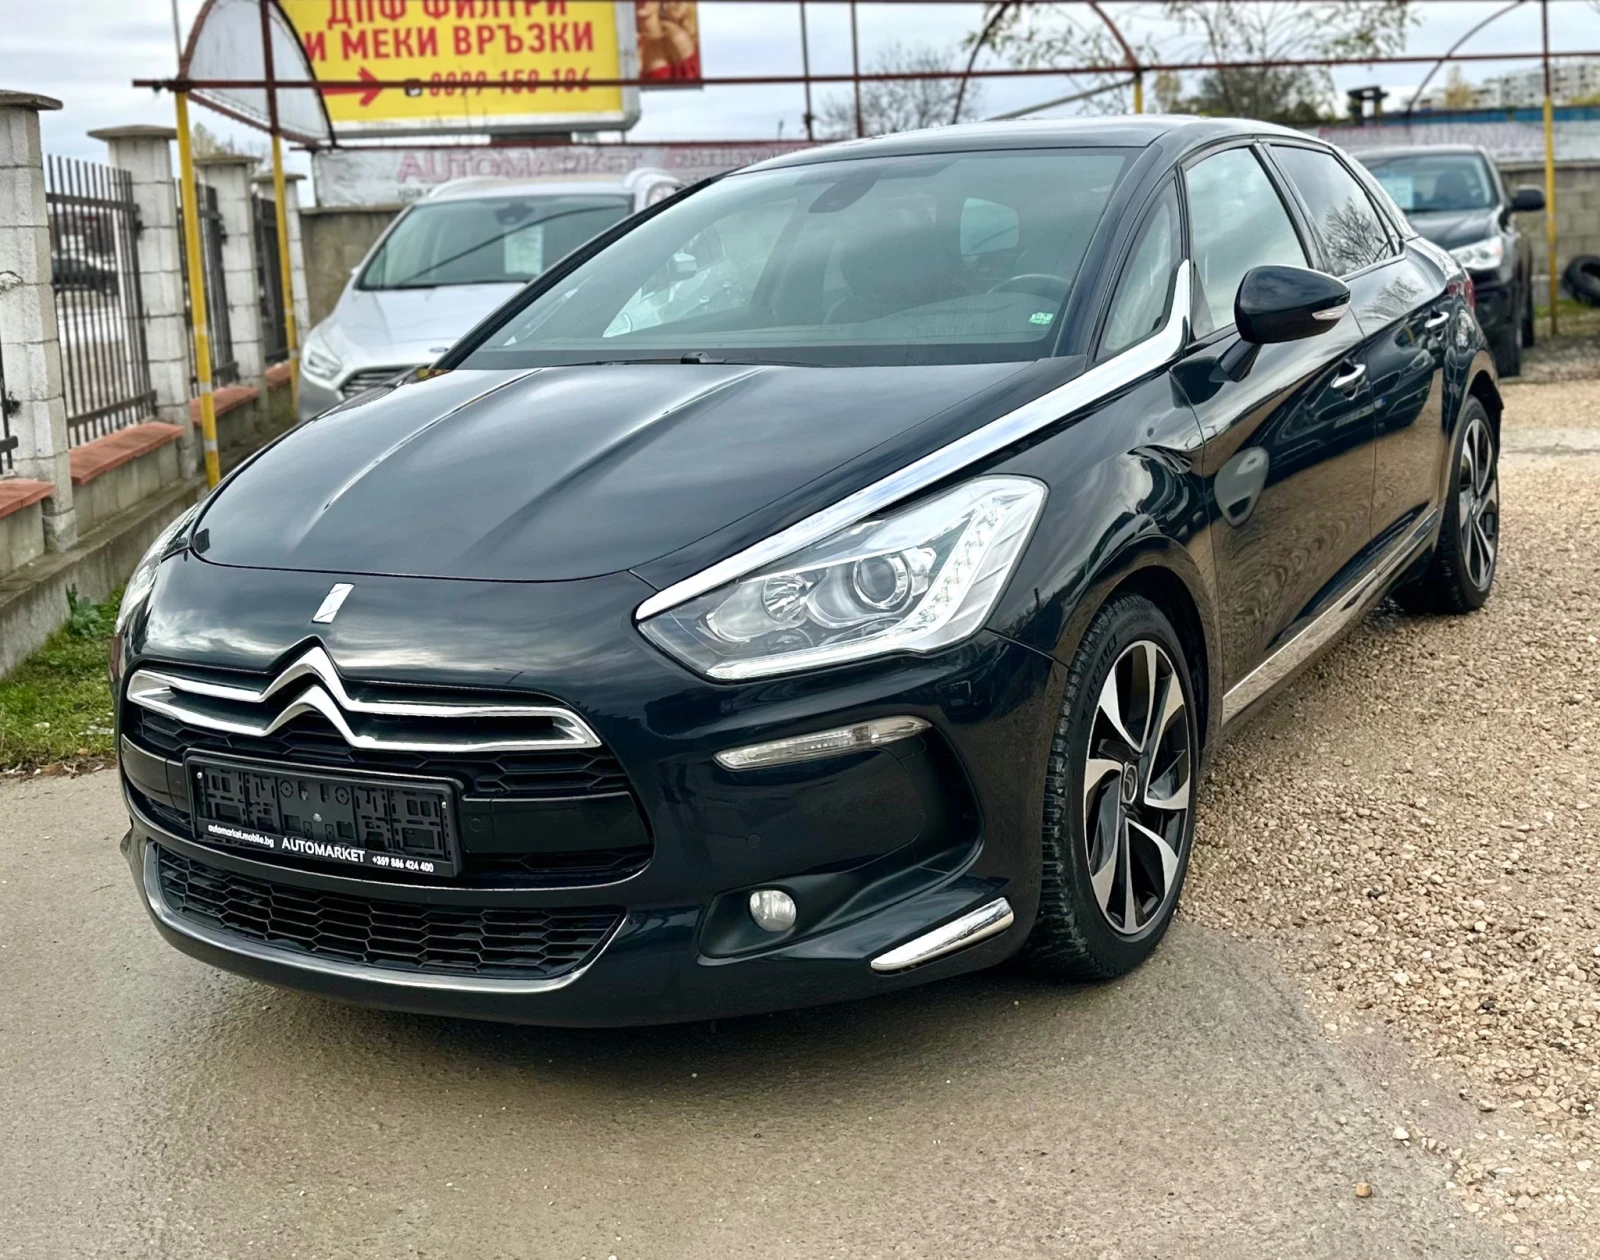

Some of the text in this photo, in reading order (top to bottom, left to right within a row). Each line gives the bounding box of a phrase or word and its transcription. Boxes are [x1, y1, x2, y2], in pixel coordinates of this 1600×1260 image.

[304, 21, 594, 62] И МЕКИ ВРЪЗКИ
[397, 149, 642, 183] AUTOMARKET
[207, 824, 434, 873] automarket.mobile.bg AUTOMARKET +359 886 424 400
